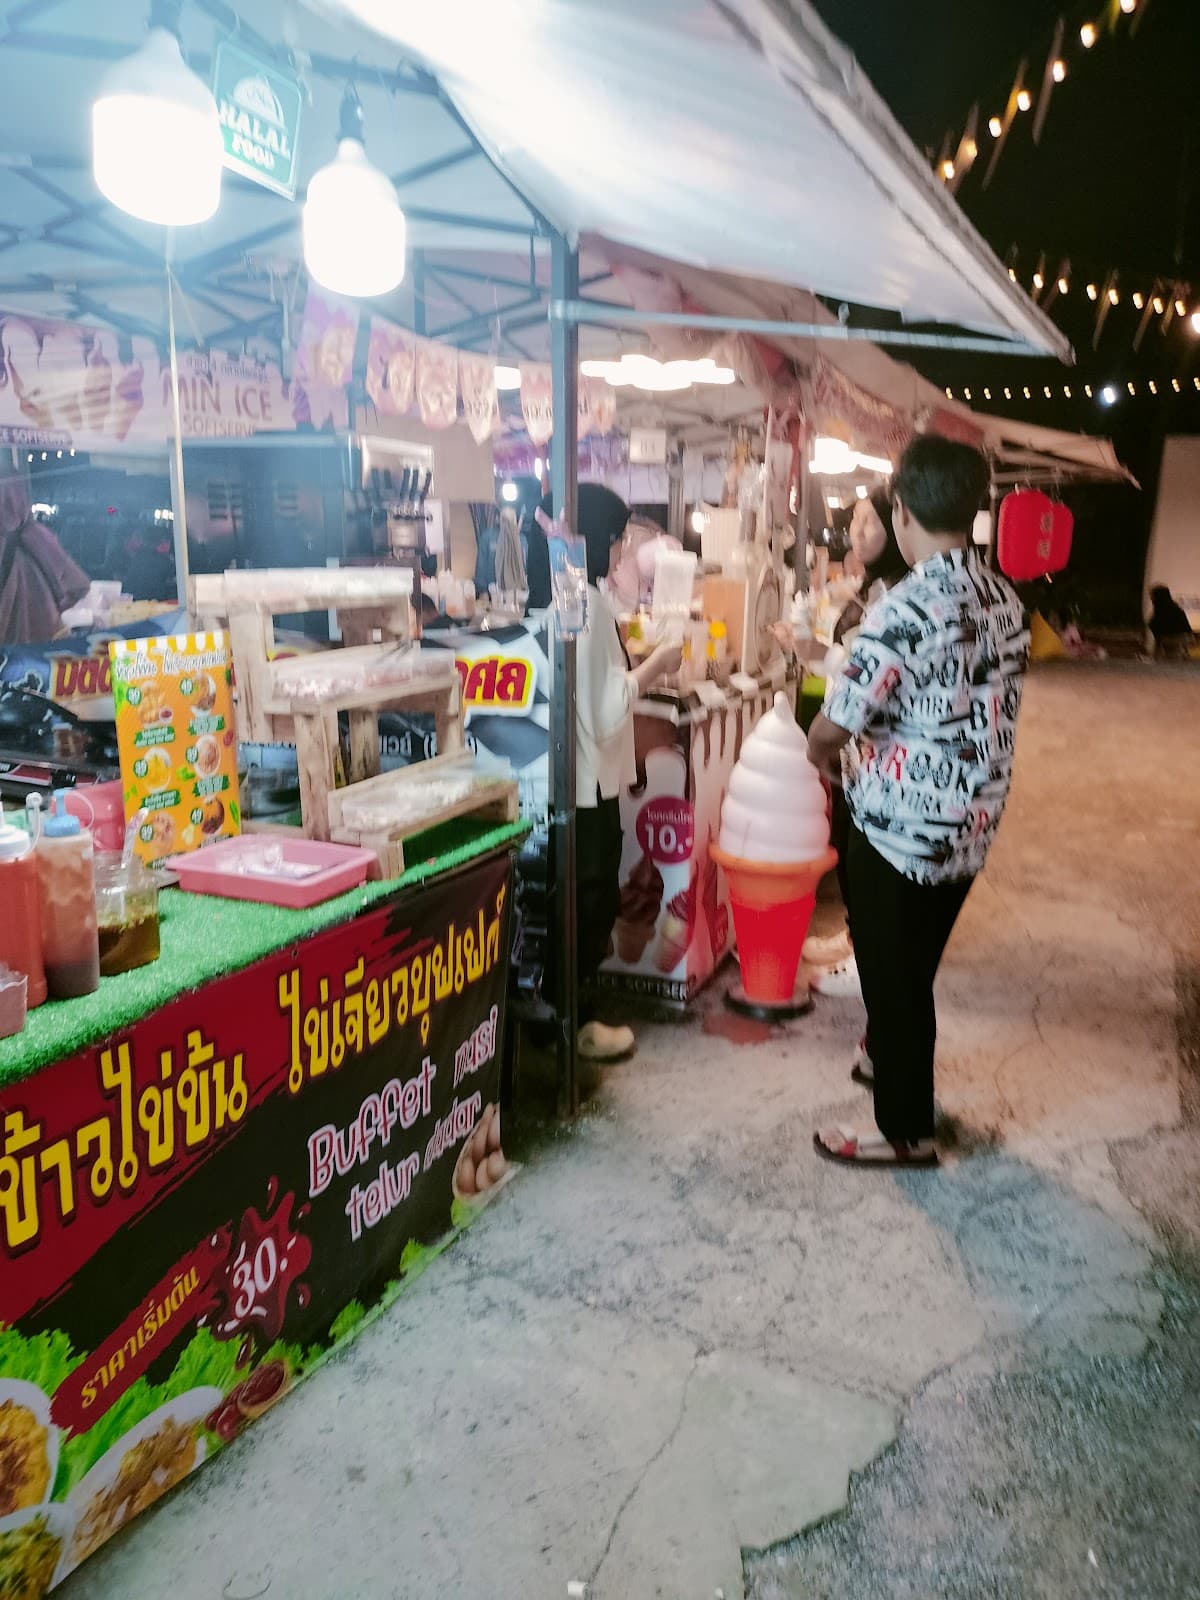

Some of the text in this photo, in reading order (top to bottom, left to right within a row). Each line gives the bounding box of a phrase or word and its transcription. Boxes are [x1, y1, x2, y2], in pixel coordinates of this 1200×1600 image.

[218, 98, 290, 160] HALAL
[232, 133, 275, 170] FOOD
[234, 383, 273, 422] ICE
[0, 1029, 249, 1249] ข้าวไข่ข้น
[308, 1004, 499, 1199] Buffet nasi
[345, 1090, 482, 1242] telur dadar
[81, 1266, 200, 1410] ราคาเริ่มต้น
